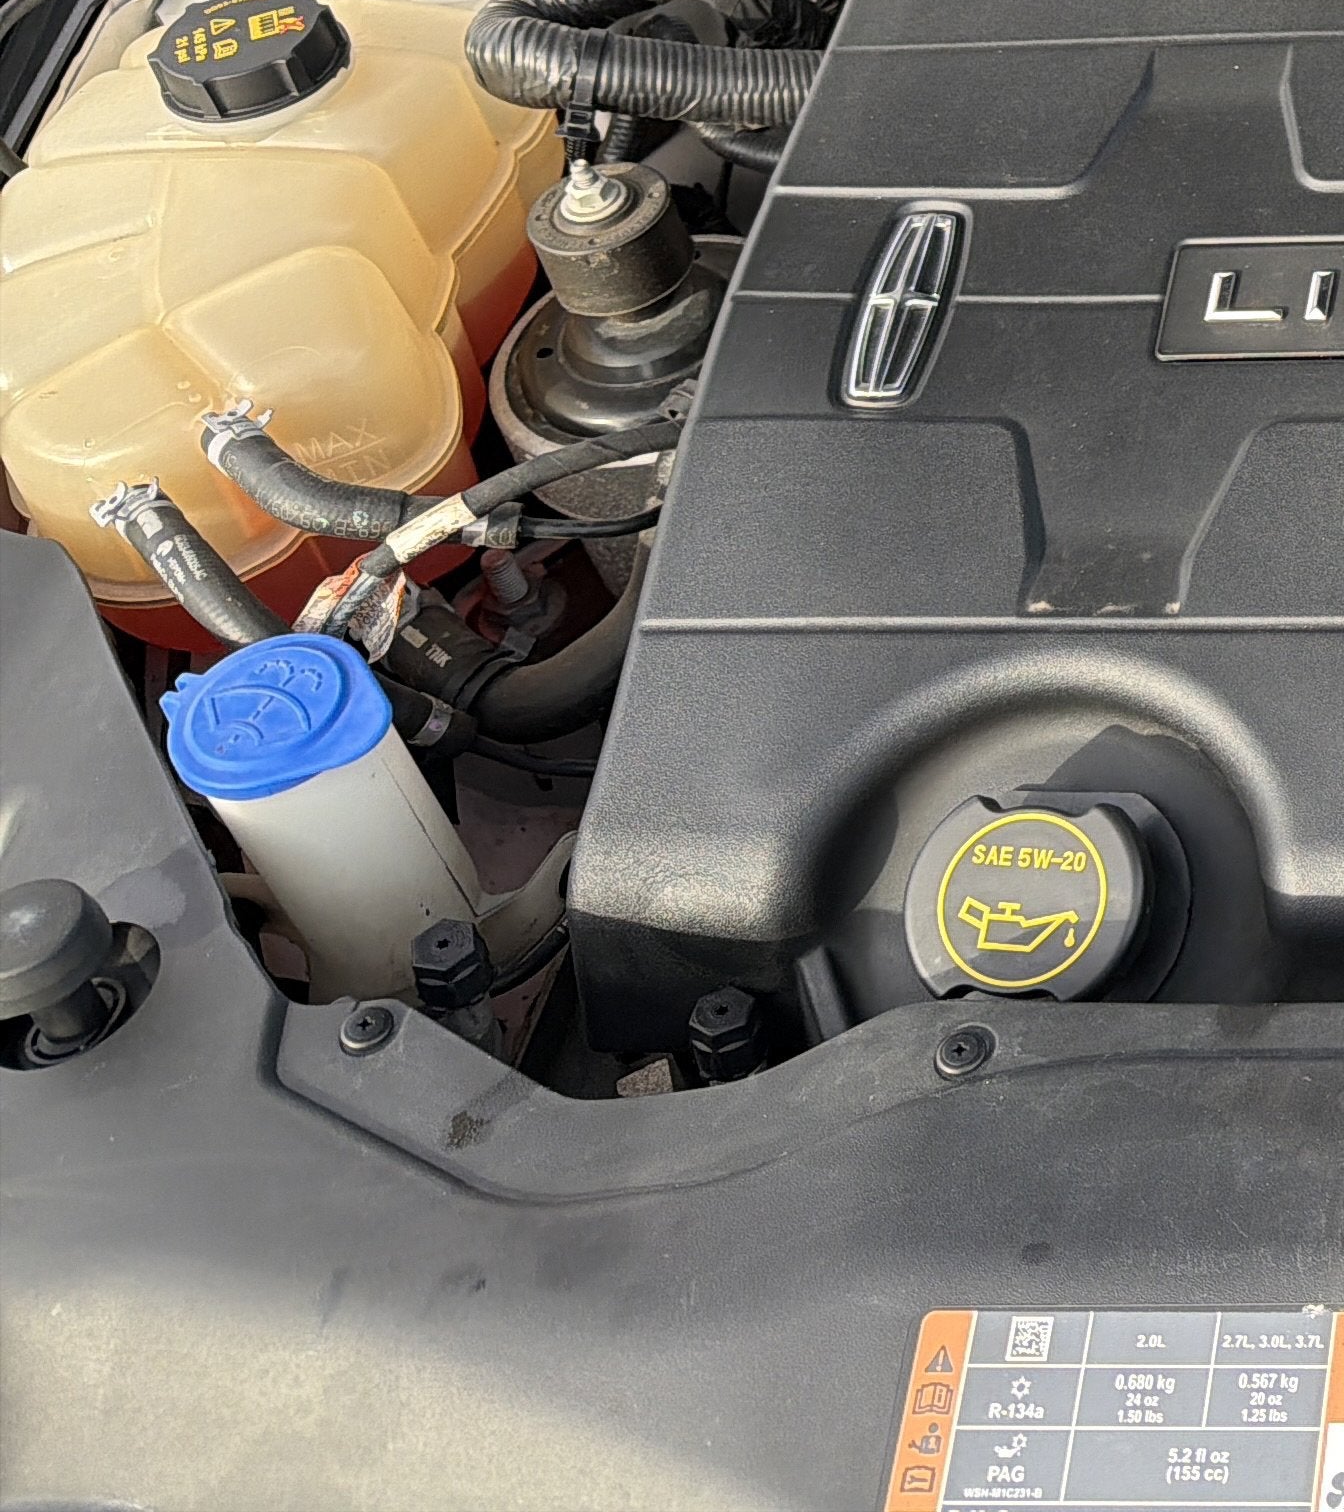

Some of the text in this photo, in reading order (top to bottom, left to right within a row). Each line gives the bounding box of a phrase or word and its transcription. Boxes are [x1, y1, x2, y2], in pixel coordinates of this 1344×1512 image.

[174, 35, 191, 64] 21 psi
[194, 44, 209, 62] kPa
[292, 416, 379, 466] MAX
[327, 449, 394, 484] IN
[971, 844, 1087, 872] SAE 5W-20
[1136, 1334, 1167, 1348] 2.0L
[1221, 1334, 1325, 1350] 2.7L, 3.0L, 3.7L
[1115, 1374, 1176, 1394] 0.680 kg
[1238, 1373, 1299, 1393] 0.567 kg
[1125, 1393, 1160, 1407] 24 oz
[1249, 1392, 1283, 1405] 20 oz
[988, 1402, 1045, 1419] R-134a
[1117, 1409, 1164, 1423] 1.50 lbs
[1241, 1408, 1288, 1422] 1.25 lbs
[1168, 1448, 1230, 1464] 5.2 fl oz
[986, 1465, 1025, 1483] PAG
[1166, 1465, 1230, 1484] (155 cc)
